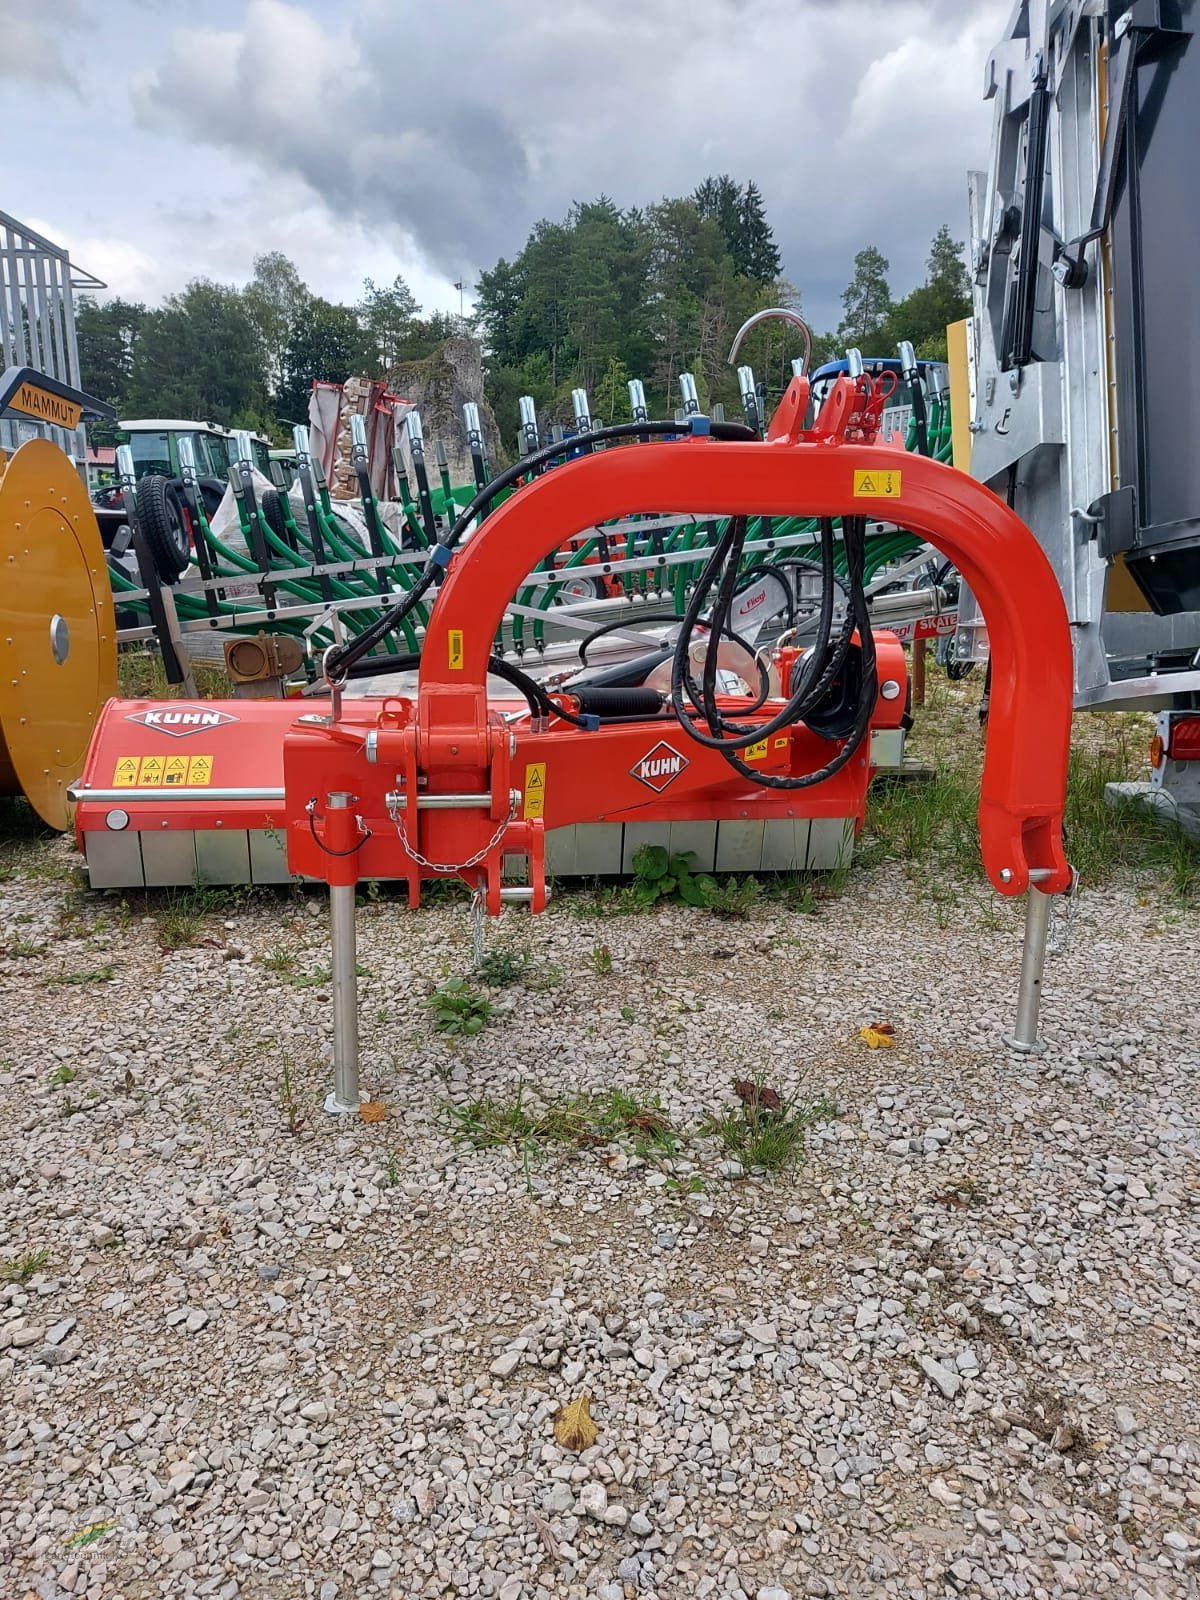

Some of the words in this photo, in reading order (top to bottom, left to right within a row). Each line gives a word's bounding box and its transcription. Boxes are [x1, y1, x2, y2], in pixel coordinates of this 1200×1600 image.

[21, 387, 74, 424] MAMMUT
[145, 713, 220, 725] KUHN
[640, 756, 680, 778] KUHN
